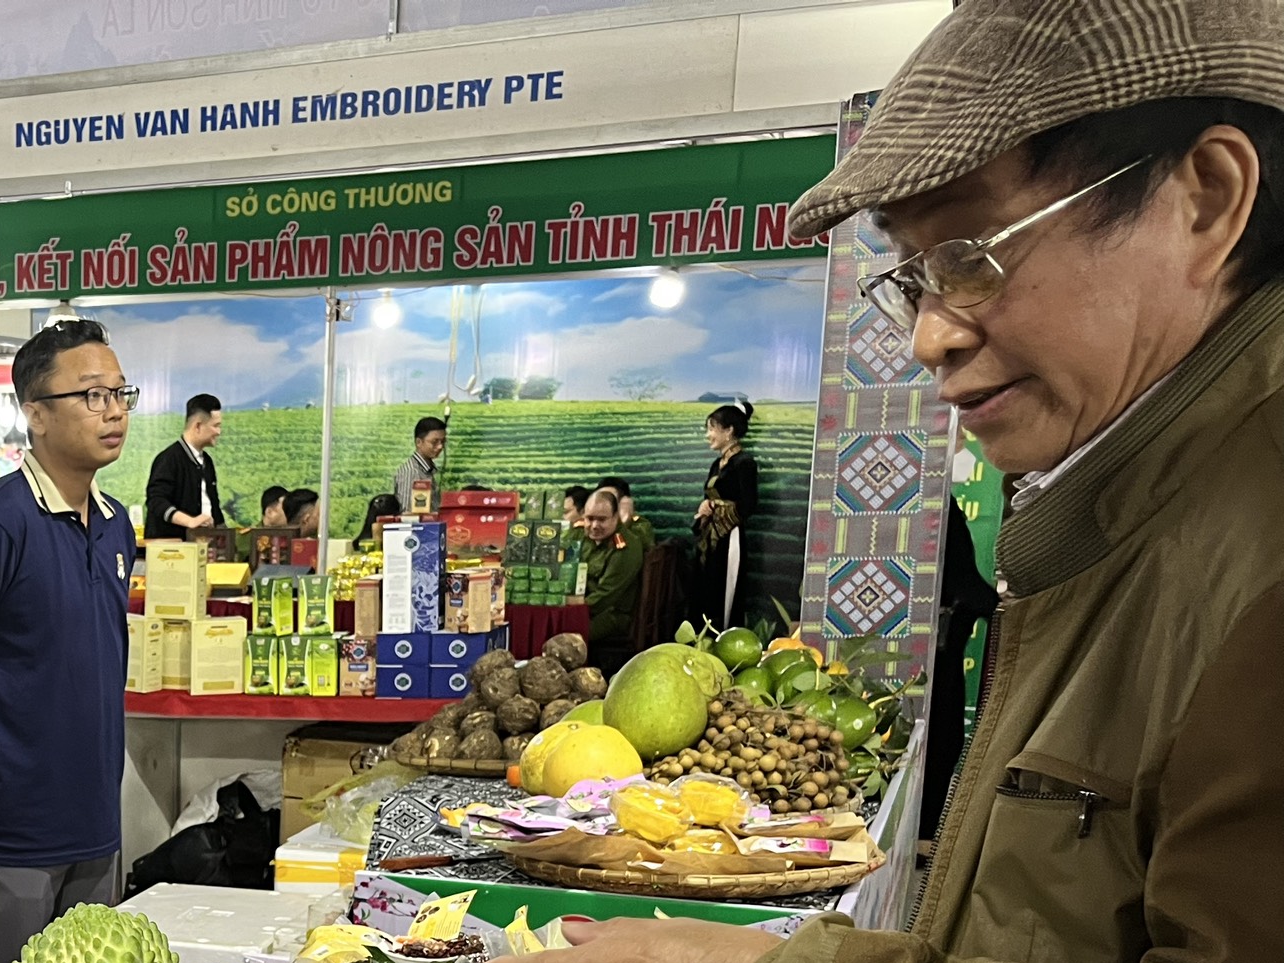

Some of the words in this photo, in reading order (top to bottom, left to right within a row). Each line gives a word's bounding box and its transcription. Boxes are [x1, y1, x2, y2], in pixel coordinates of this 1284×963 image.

[15, 112, 125, 148] NGUYEN
[134, 108, 190, 138] VAN
[200, 99, 280, 131] HANH
[292, 77, 493, 123] EMBROIDERY
[503, 70, 564, 105] PTE
[226, 187, 259, 217] SỞ
[266, 187, 337, 215] CÔNG
[344, 180, 453, 209] THƯƠNG
[14, 237, 74, 292] KẾT
[81, 233, 139, 289] NỐI
[147, 227, 217, 286] SẢN
[225, 221, 331, 282] PHẨM
[339, 224, 444, 277] NÔNG
[453, 205, 536, 268] SẢN
[547, 201, 640, 264] TỈNH
[648, 198, 745, 260] THÁI
